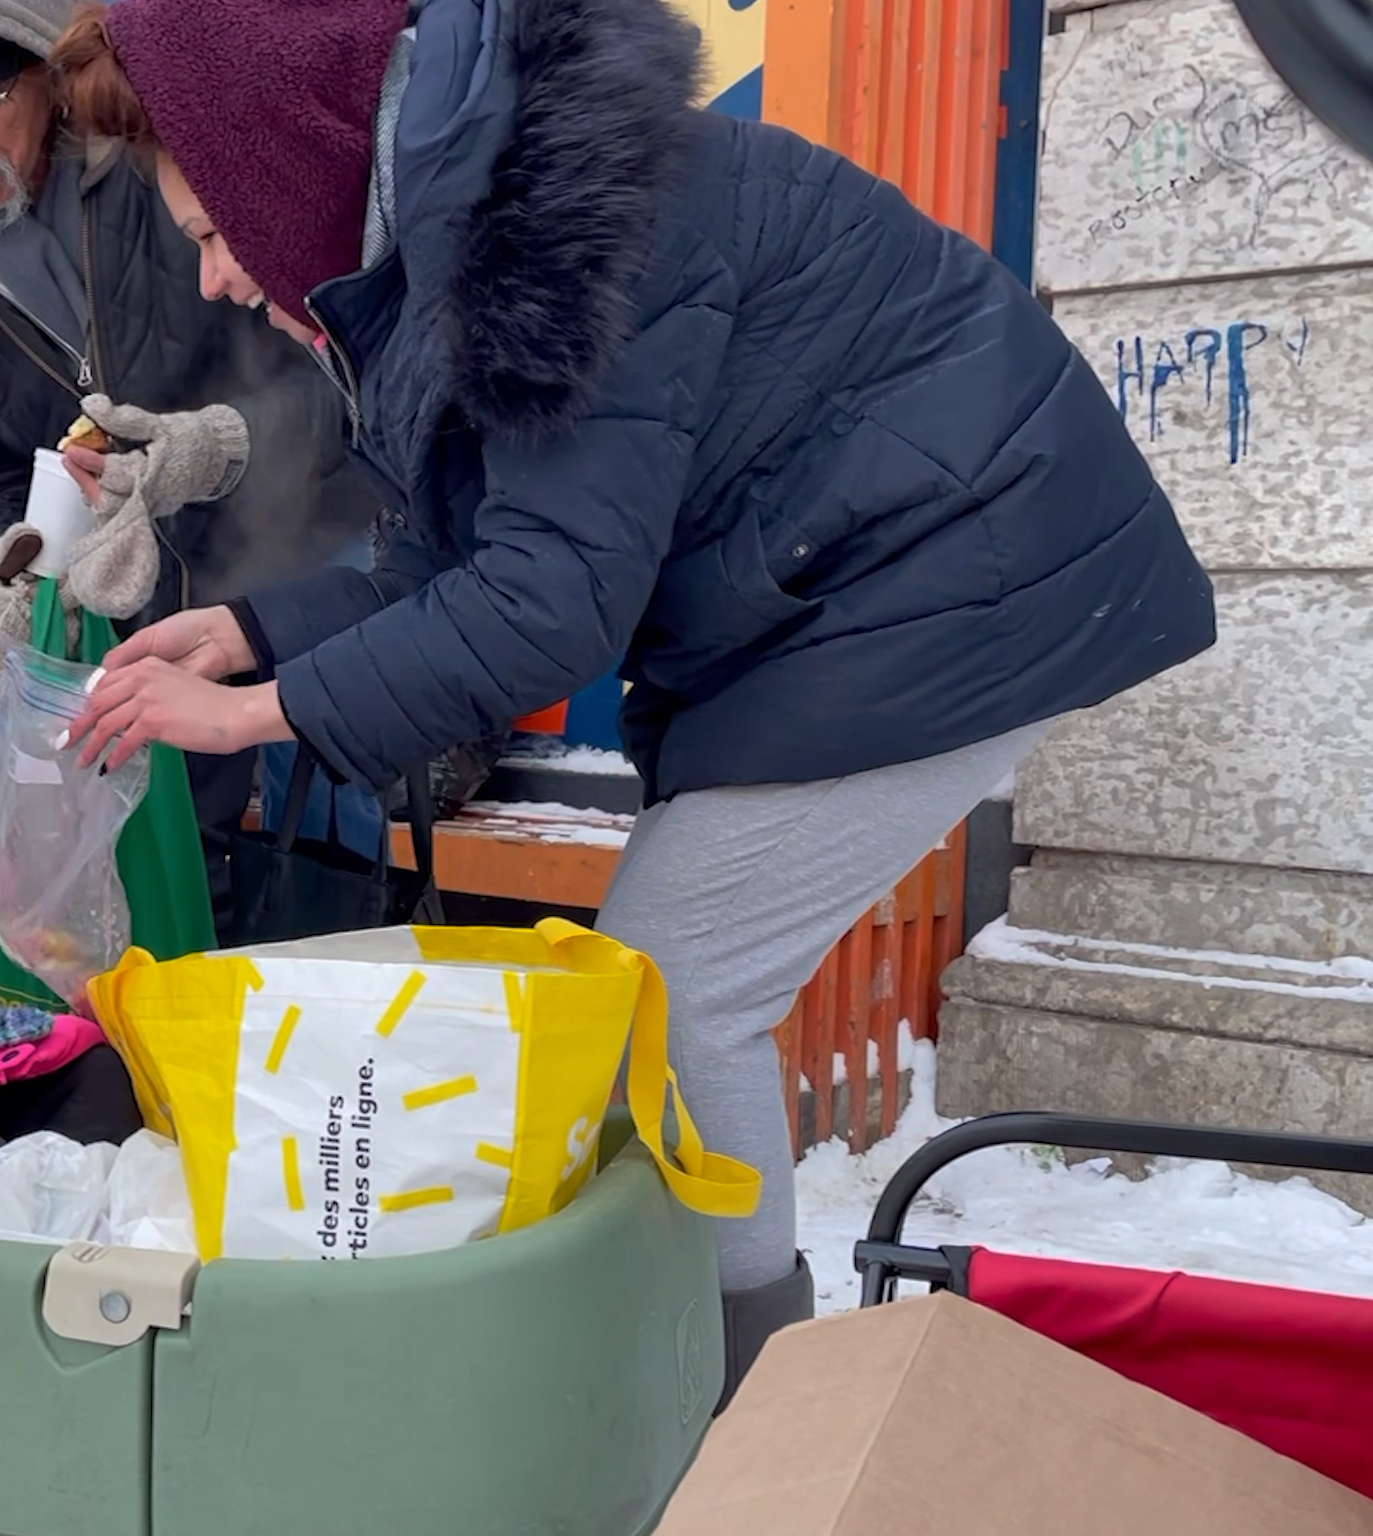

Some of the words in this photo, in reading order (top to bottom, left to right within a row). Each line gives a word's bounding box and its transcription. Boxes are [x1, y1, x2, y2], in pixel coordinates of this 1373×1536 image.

[1116, 316, 1310, 464] HAPPY
[351, 1058, 378, 1129] ligne.
[319, 1095, 345, 1192] milliers
[355, 1137, 371, 1169] en
[317, 1199, 340, 1247] des
